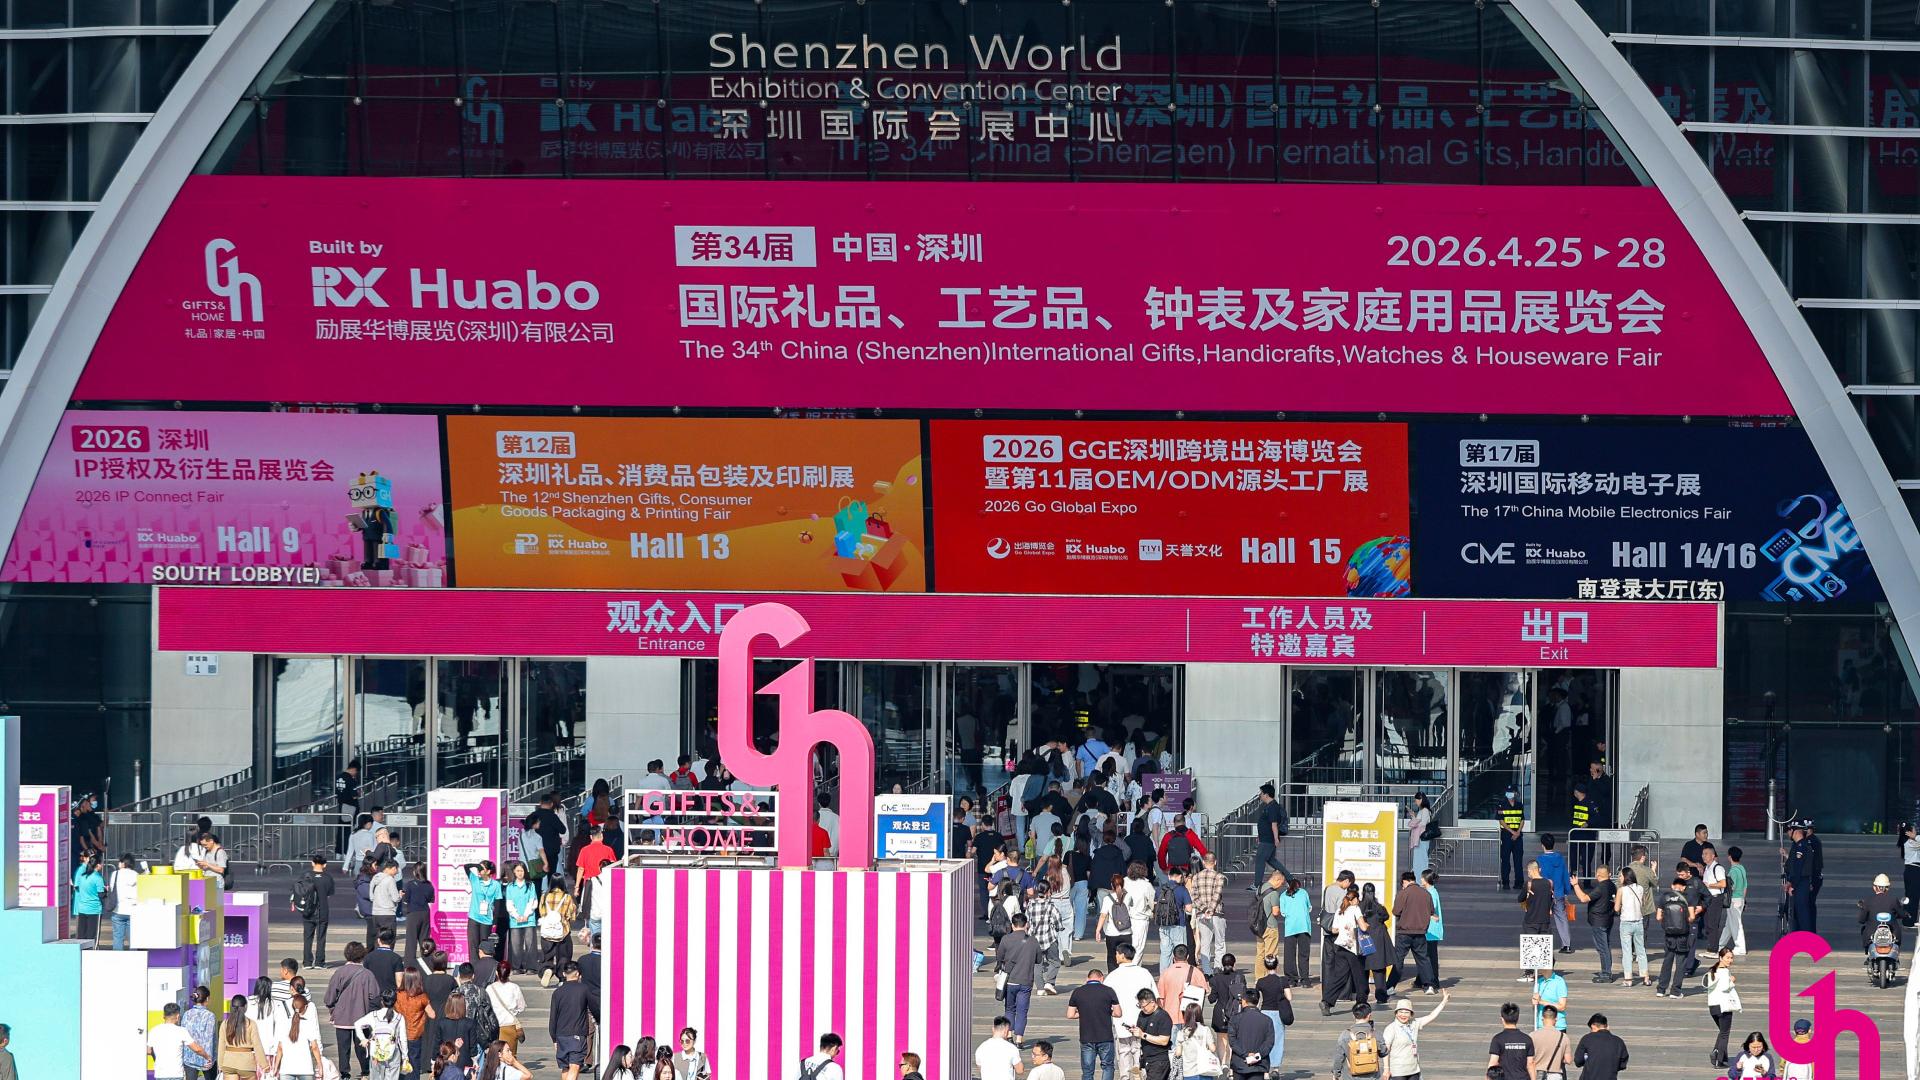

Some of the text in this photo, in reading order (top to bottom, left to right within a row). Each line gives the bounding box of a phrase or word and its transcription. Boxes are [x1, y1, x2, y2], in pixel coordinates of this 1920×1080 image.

[709, 33, 1122, 71] Shenzhen World
[710, 77, 1121, 102] Exhibition & Convention Center
[713, 109, 1122, 142] 深圳国际会展中心
[309, 240, 383, 258] Built by
[690, 232, 983, 263] 第34届 中国·深圳
[1386, 235, 1666, 268] 2026.4.25 28
[311, 266, 600, 311] RX Huabo
[182, 300, 226, 310] GIFTS&
[191, 312, 225, 322] HOME
[315, 319, 614, 344] 励展华博展览(深圳)有限公司
[679, 340, 725, 359] The
[732, 340, 773, 359] 34th
[781, 340, 848, 360] China
[1451, 346, 1468, 365] &
[1476, 347, 1609, 366] Houseware
[1617, 347, 1663, 367] Fair
[79, 428, 209, 451] 2026 深圳
[501, 434, 572, 456] 第12届
[991, 438, 1363, 463] 2026 GGE深圳跨境出海博览会
[1465, 443, 1535, 464] 第17届
[74, 457, 335, 482] IP授权及衍生品展览会
[498, 462, 855, 489] 深圳礼品、消费品包装及印刷展
[984, 466, 1369, 493] 暨第11届OEM/ODM源头工厂展
[75, 489, 225, 503] 2026 IP Connect Fair
[1460, 471, 1701, 496] 深圳国际移动电子展
[500, 490, 753, 508] The 12nd Shenzhen Gifts, Consumer
[984, 500, 1138, 516] 2026 Go Global Expo
[500, 505, 731, 522] Goods Packaging & Printing Fair
[1460, 505, 1732, 520] The 17th China Mobile Electronics Fair
[157, 533, 197, 543] Huabo
[217, 526, 300, 553] Hall 9
[568, 539, 608, 549] Huabo
[630, 532, 730, 560] Hall 13
[1086, 544, 1126, 554] Huabo
[1165, 543, 1223, 558] 天誉文化
[1241, 537, 1342, 564] Hall 15
[1460, 542, 1516, 565] CME
[1546, 548, 1586, 559] Huabo
[1612, 541, 1757, 569] Hall 14/16
[152, 565, 321, 584] SOUTH LOBBY(E)
[1577, 578, 1725, 601] 南登录大厅(东)
[1241, 605, 1374, 631] 工作人员及
[1521, 609, 1589, 644] 出口
[638, 636, 706, 651] Entrance
[1250, 633, 1356, 659] 特邀嘉宾
[1540, 646, 1569, 660] Exit
[642, 790, 761, 817] GIFTS&
[664, 826, 755, 852] HOME
